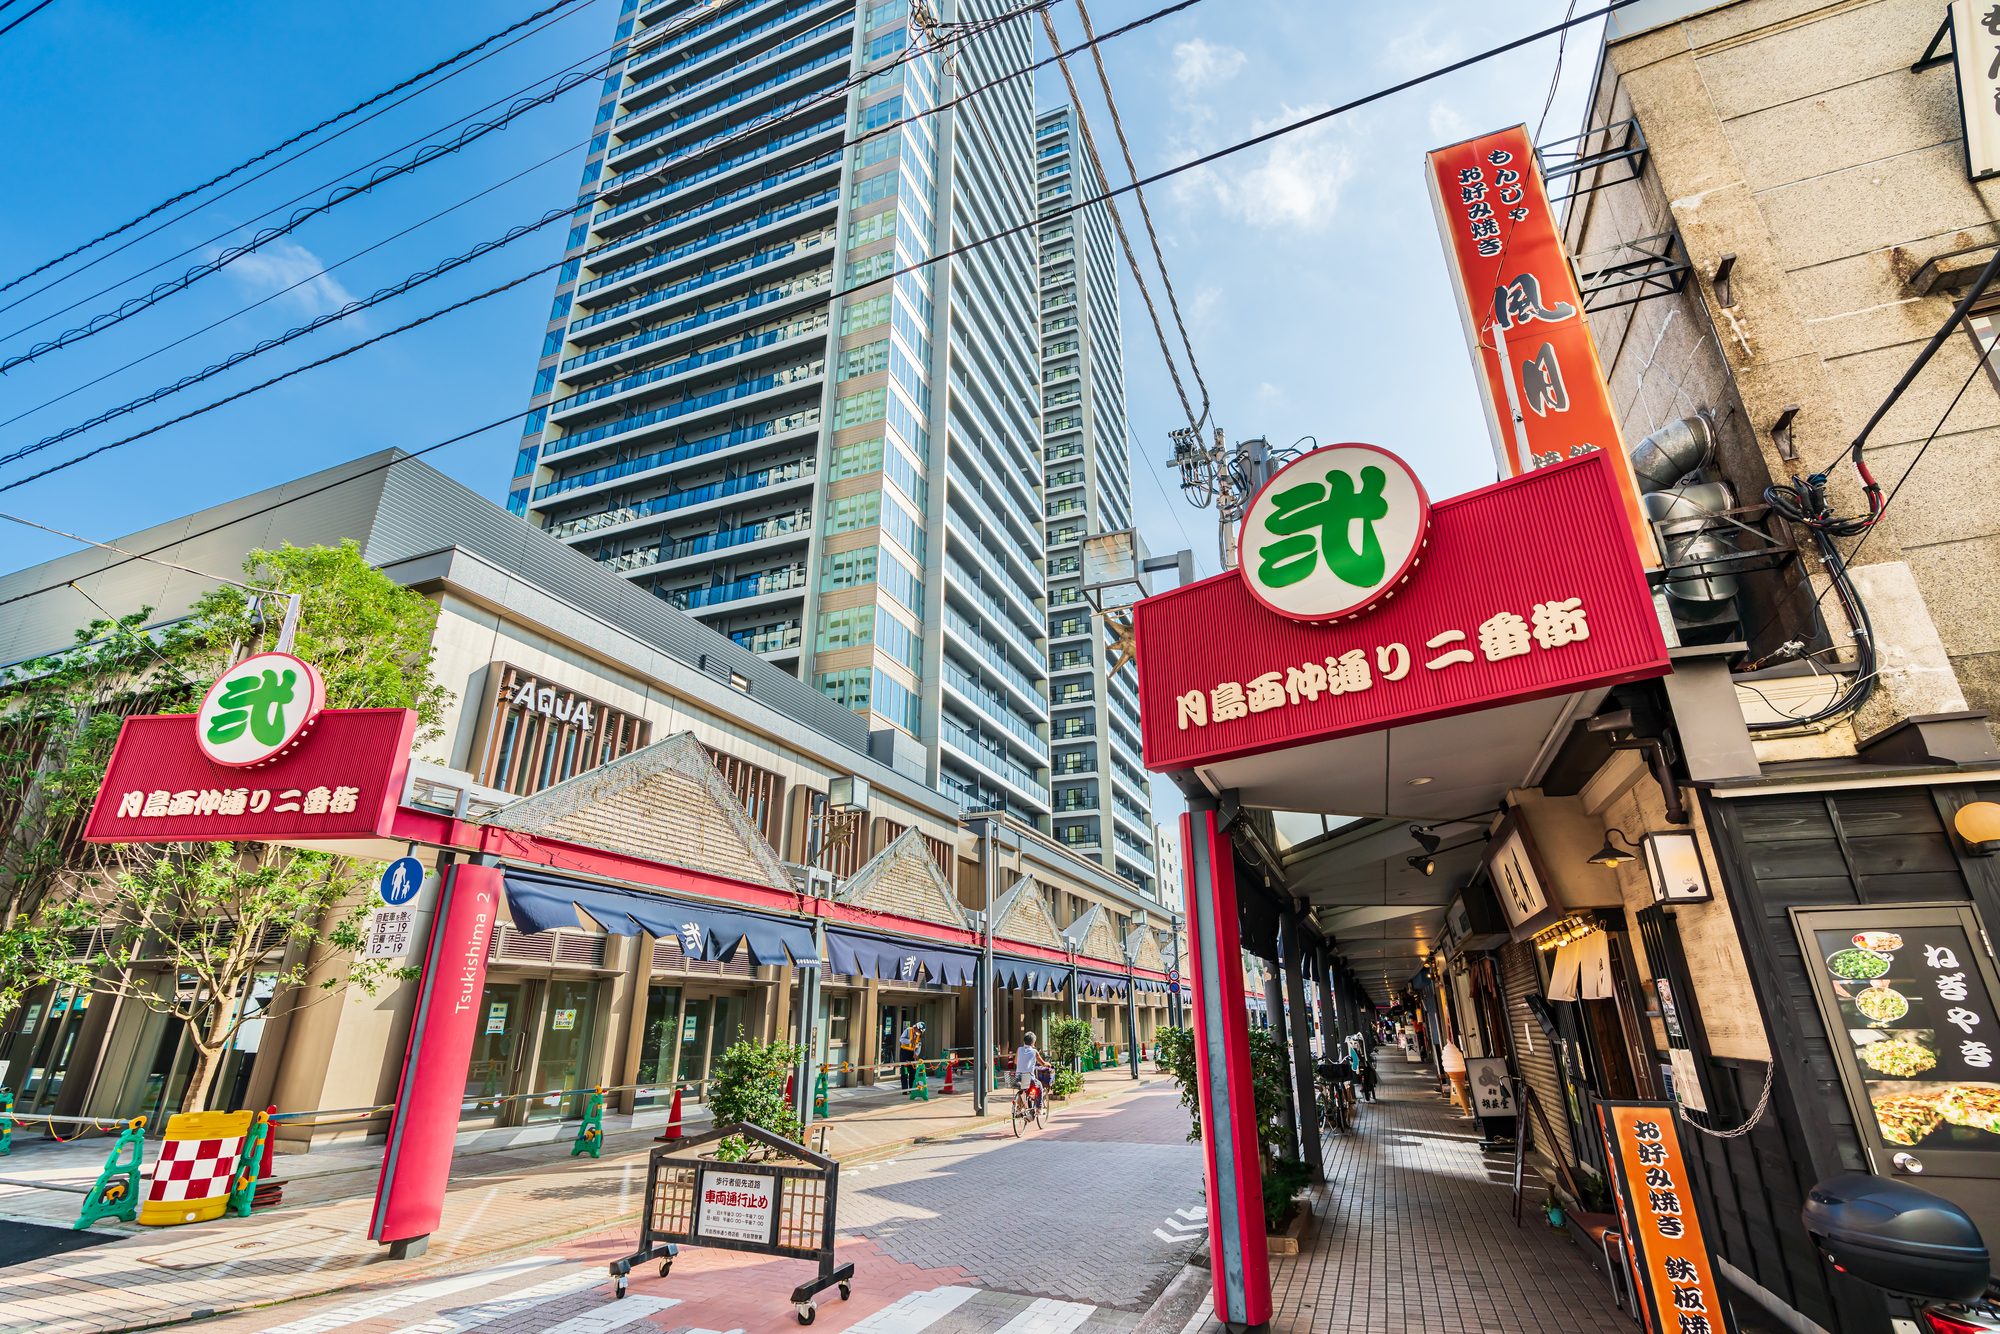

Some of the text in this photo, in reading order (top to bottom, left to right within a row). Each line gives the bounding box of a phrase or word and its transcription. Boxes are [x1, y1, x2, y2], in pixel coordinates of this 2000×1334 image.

[1457, 166, 1502, 257] お好み焼き
[1488, 150, 1529, 222] もんじゃ
[1494, 273, 1576, 417] 風月
[513, 682, 589, 730] AQUA
[376, 912, 411, 922] 自転車を除く
[455, 893, 490, 1014] Tsukishima 2
[1923, 943, 1993, 1068] ねぎやき
[705, 1189, 768, 1209] 車両通行止め
[716, 1177, 760, 1189] 歩行者優先道路
[1633, 1119, 1685, 1239] お好み焼き
